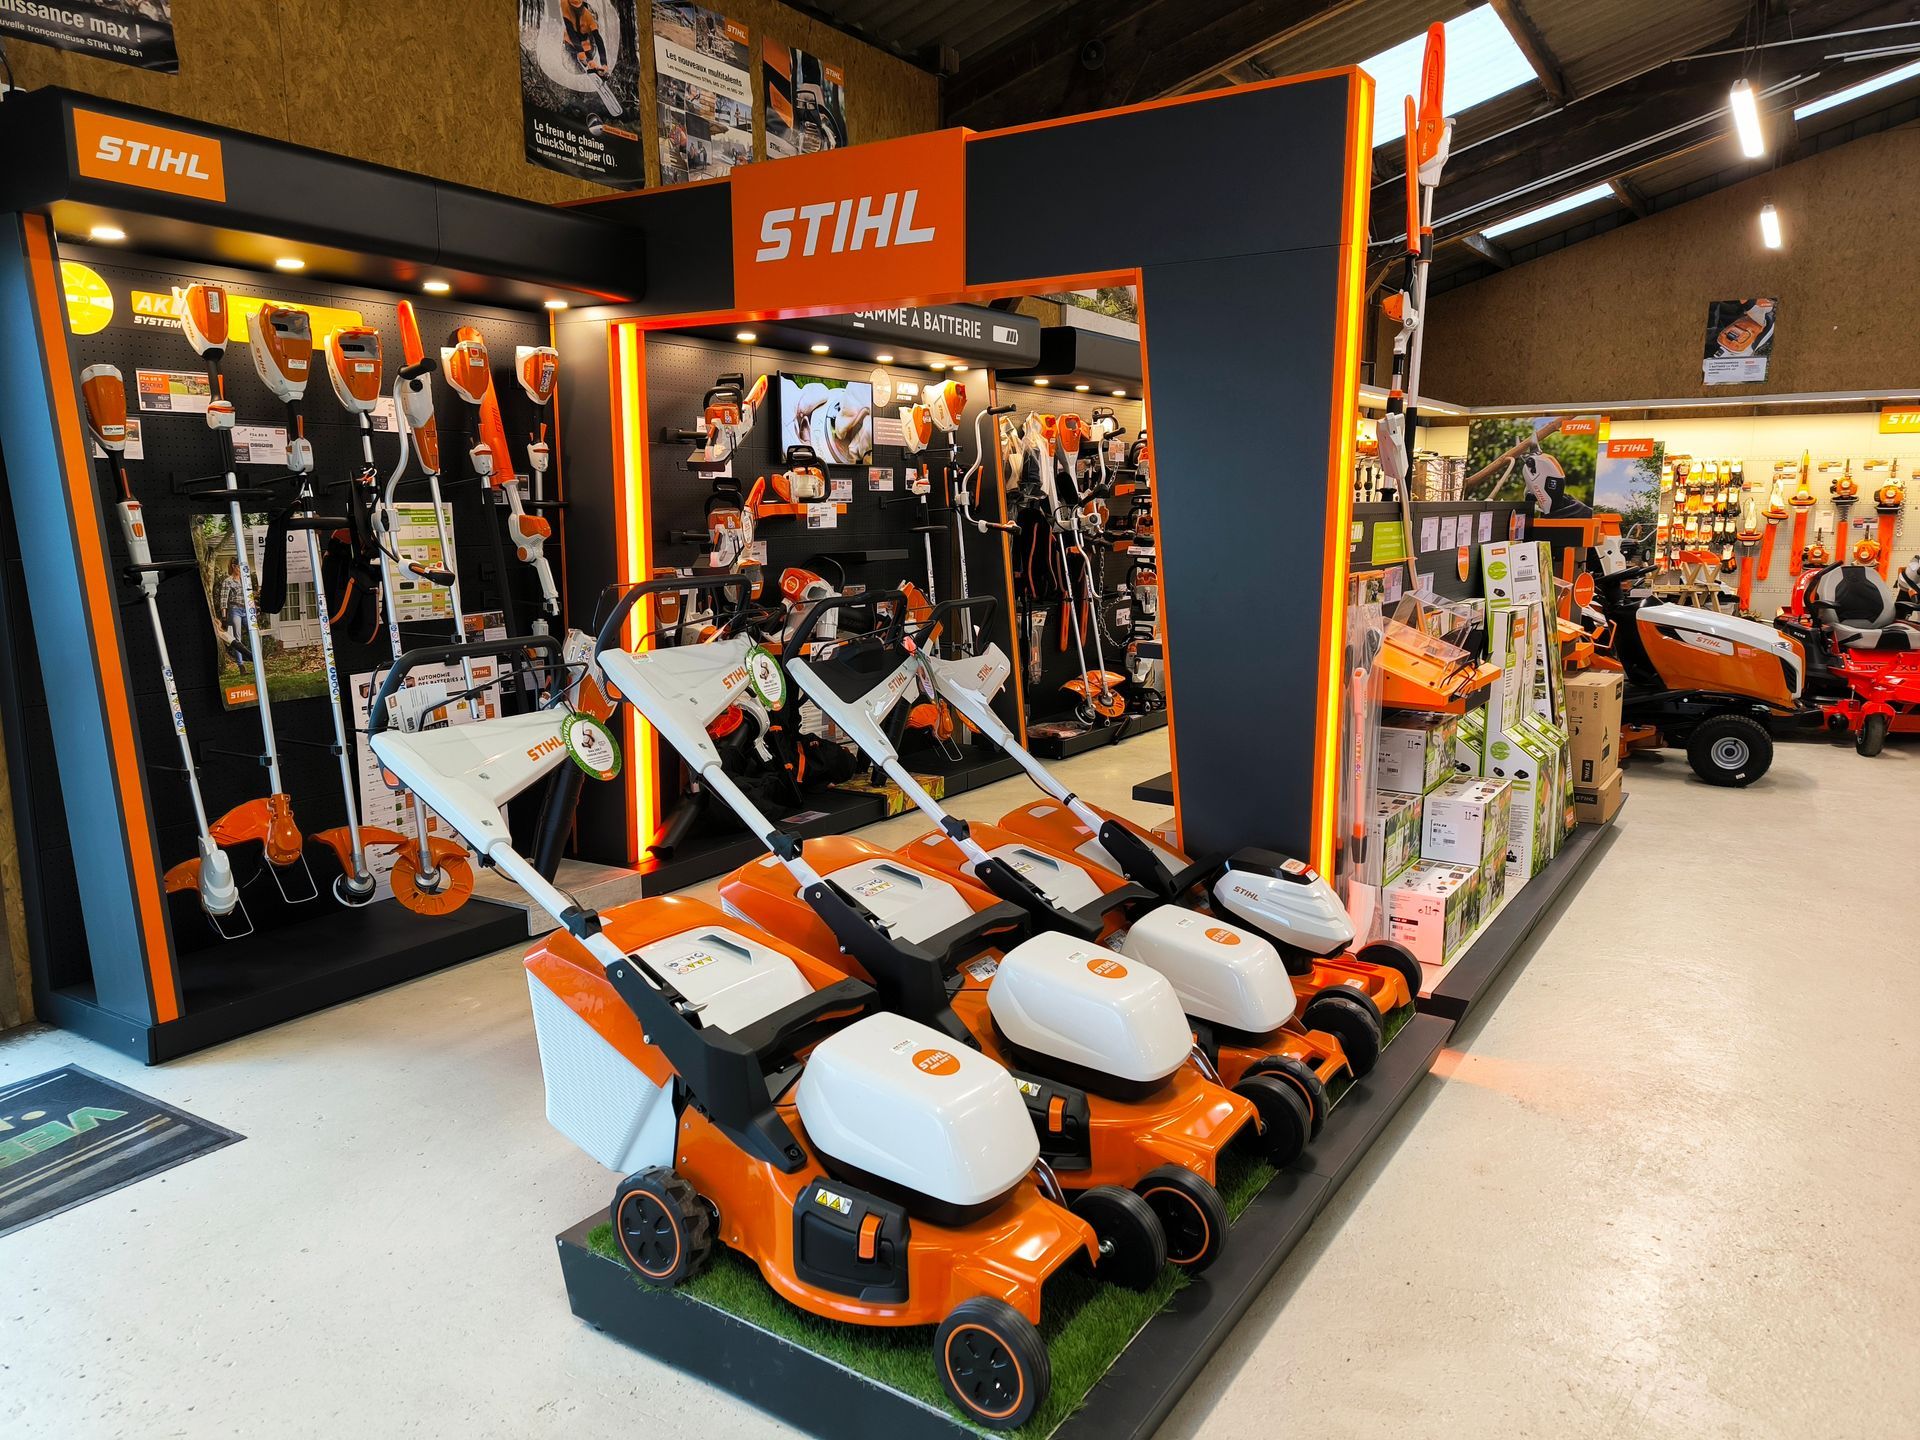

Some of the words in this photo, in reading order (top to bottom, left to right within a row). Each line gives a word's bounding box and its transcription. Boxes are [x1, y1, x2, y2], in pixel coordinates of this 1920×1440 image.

[90, 17, 130, 40] max
[135, 24, 142, 43] !
[727, 24, 746, 39] STIHL
[27, 24, 86, 44] tronçonneuse
[86, 38, 112, 51] STIHL
[113, 44, 128, 55] MS
[129, 48, 144, 58] 391
[665, 49, 677, 61] Les
[677, 56, 707, 74] nouveaux
[708, 68, 743, 87] multitalents
[825, 67, 842, 81] STIHL
[534, 118, 544, 132] Le
[545, 122, 565, 139] frein
[566, 130, 577, 143] de
[578, 134, 605, 151] chaîne
[95, 135, 210, 182] STIHL
[535, 132, 577, 157] QuickStop
[578, 145, 602, 162] Super
[602, 152, 618, 168] (Q).
[755, 189, 936, 263] STIHL
[134, 315, 182, 329] SYSTEM
[923, 311, 981, 340] BATTERIE
[255, 346, 268, 375] STIHL
[1565, 423, 1592, 431] STIHL
[1612, 444, 1649, 453] STIHL
[1696, 636, 1721, 648] STIHL
[418, 672, 450, 681] AUTONOMIE
[722, 665, 749, 690] STIHL
[887, 672, 908, 693] STIHL
[976, 663, 993, 682] STIHL
[230, 688, 254, 700] STIHL
[526, 735, 566, 762] STIHL
[1233, 885, 1259, 902] STIHL
[1094, 960, 1116, 975] STIHL
[918, 1051, 949, 1070] STIHL
